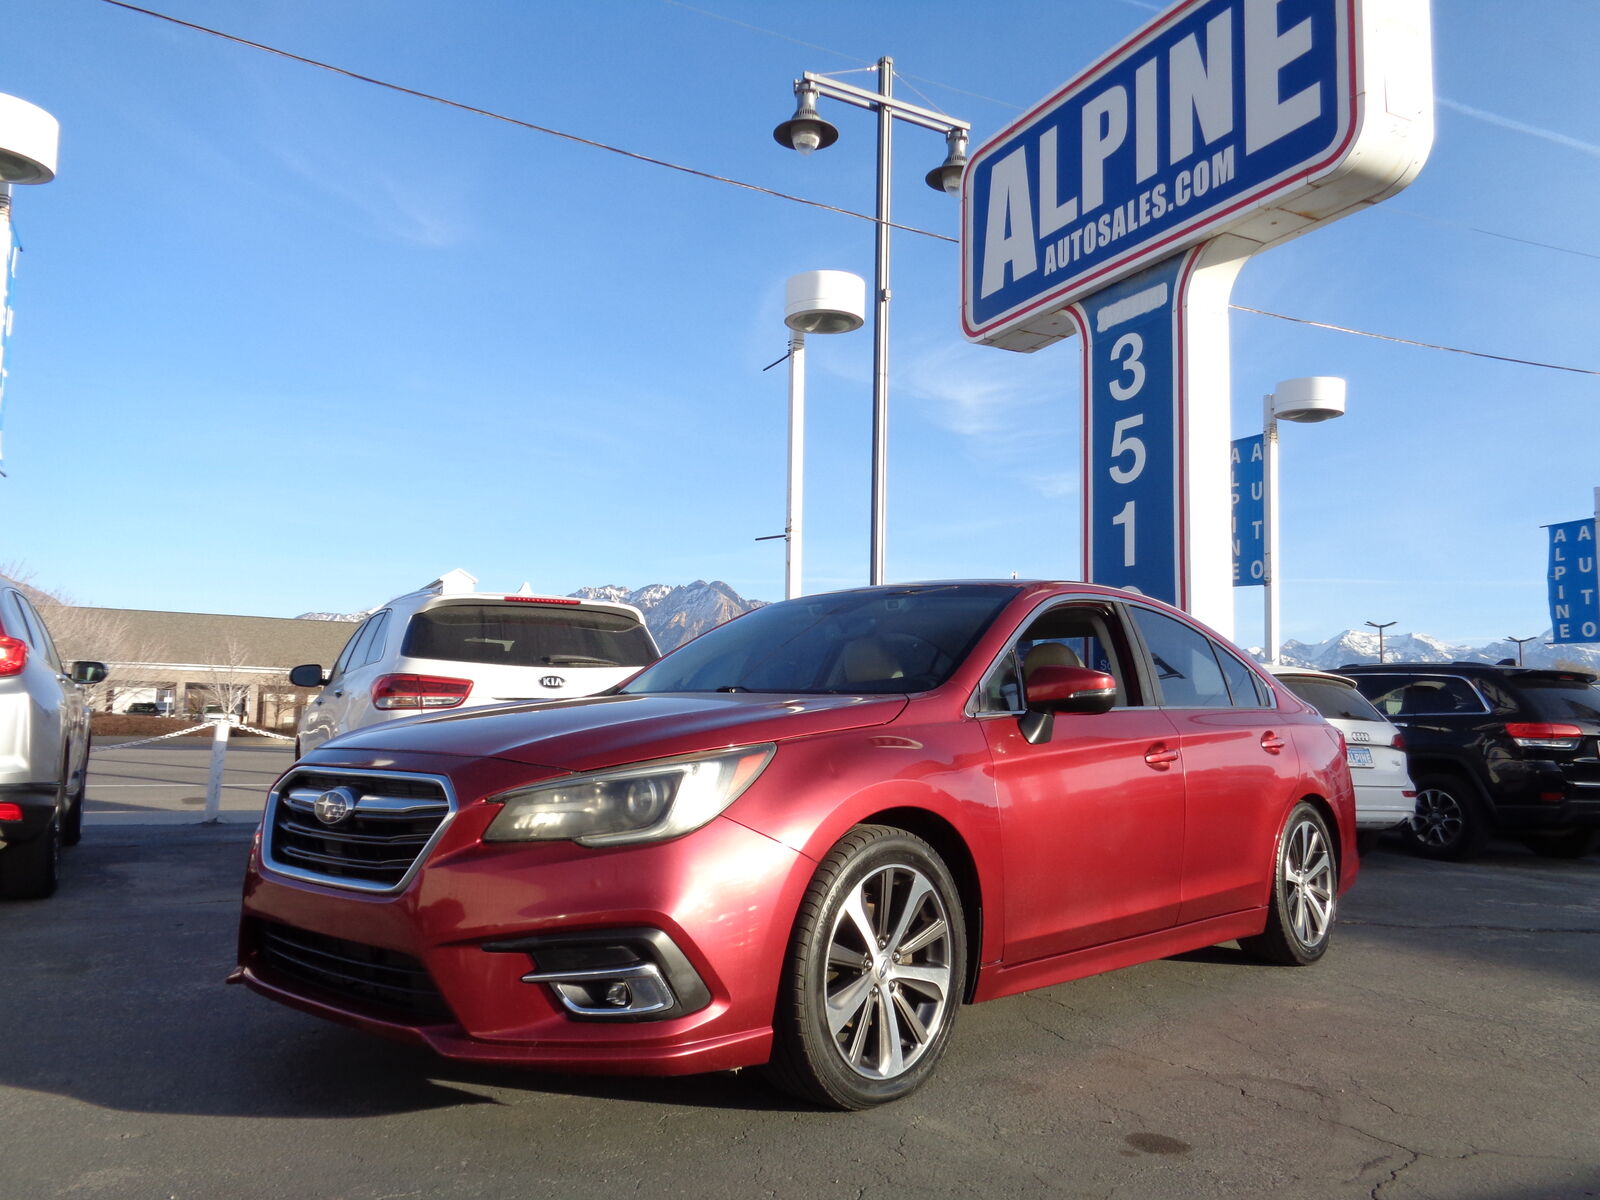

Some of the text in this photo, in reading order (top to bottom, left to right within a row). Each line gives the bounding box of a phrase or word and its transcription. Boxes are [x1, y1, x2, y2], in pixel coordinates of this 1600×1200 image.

[981, 0, 1321, 300] ALPINE
[1044, 145, 1234, 277] AUTOSALES.COM
[1109, 332, 1147, 595] 351
[1251, 443, 1264, 579] AUTO
[1554, 529, 1570, 638] ALPINE
[1577, 525, 1597, 637] AUTO
[543, 677, 563, 686] KIA
